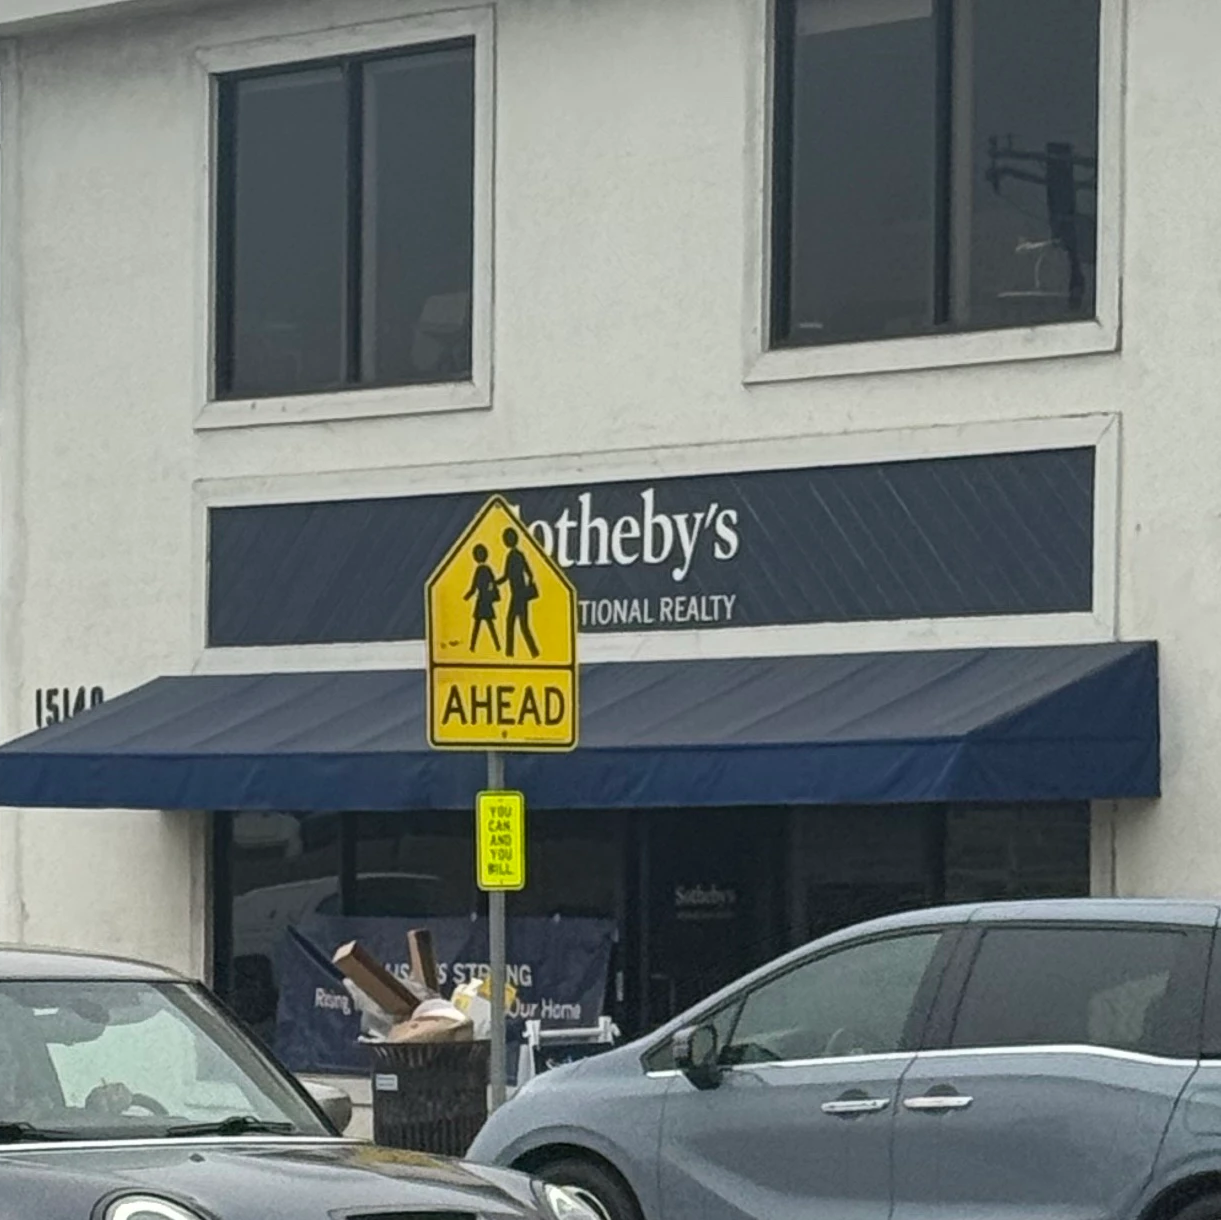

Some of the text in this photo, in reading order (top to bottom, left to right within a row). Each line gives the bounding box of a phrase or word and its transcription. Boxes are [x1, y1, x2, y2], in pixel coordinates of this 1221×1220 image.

[511, 488, 739, 581] otheby's
[660, 595, 736, 622] REALTY
[441, 684, 565, 726] AHEAD
[489, 806, 512, 818] YOU
[488, 820, 511, 832] CAN
[489, 834, 512, 846] AND
[489, 848, 513, 861] YOU
[452, 962, 532, 987] STRNG
[314, 987, 351, 1015] Rising
[541, 1001, 581, 1020] Home
